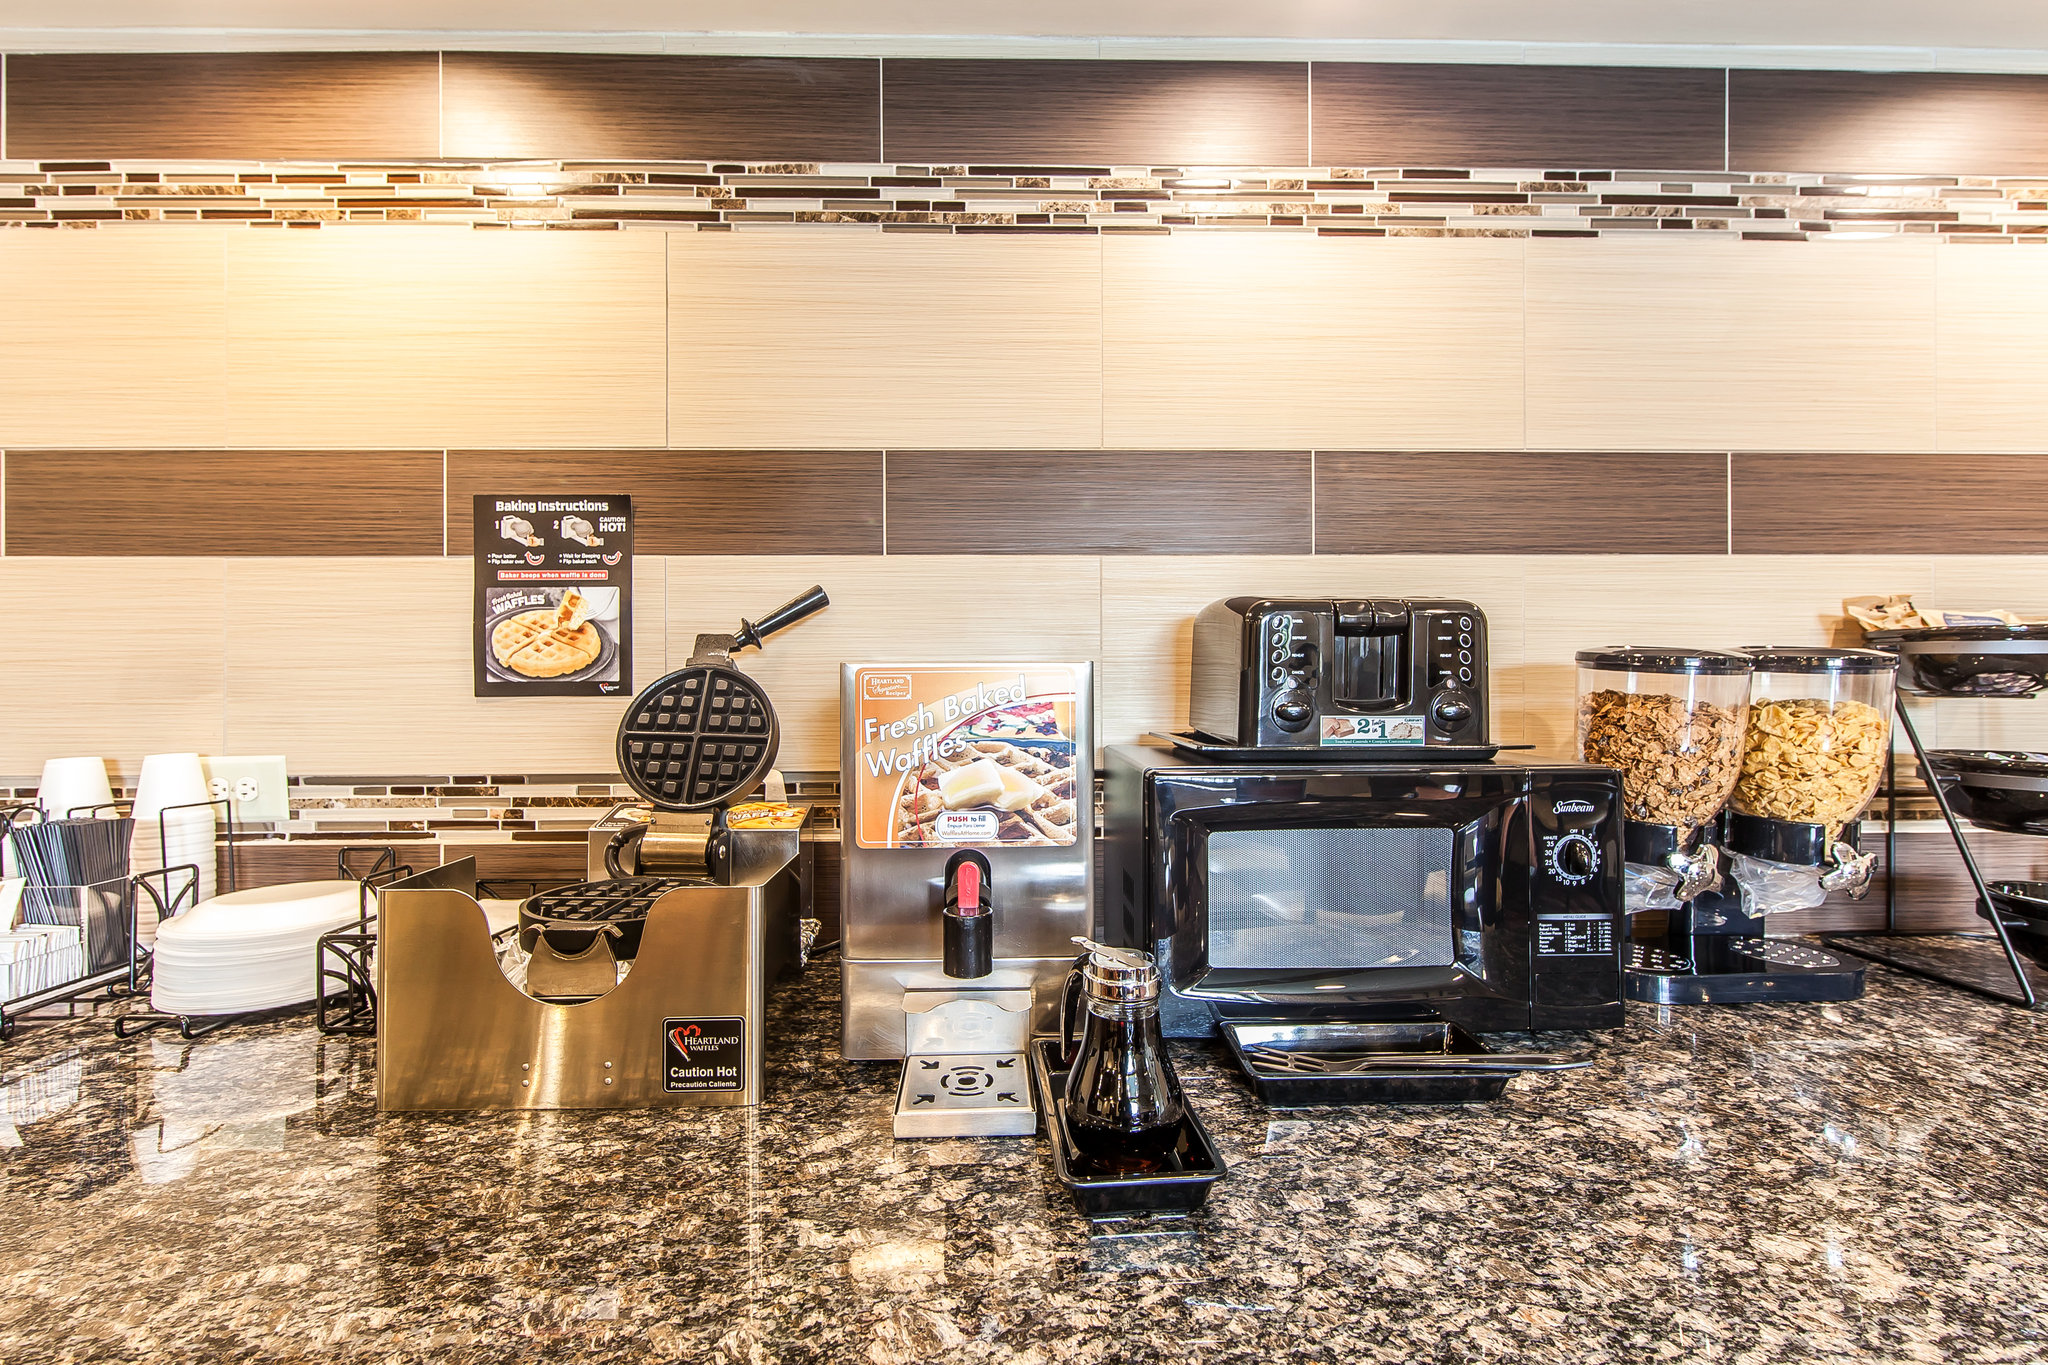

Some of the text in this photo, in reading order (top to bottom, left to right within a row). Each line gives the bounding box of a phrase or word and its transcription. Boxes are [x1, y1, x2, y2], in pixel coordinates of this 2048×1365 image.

[496, 499, 609, 513] Baking Instructions
[494, 520, 500, 530] 1
[553, 520, 559, 530] 2
[599, 523, 626, 532] HOT!
[492, 594, 545, 614] WAFFLES
[864, 673, 1027, 744] Fresh Baked
[1357, 718, 1370, 734] 2
[1378, 723, 1388, 738] 1
[864, 732, 968, 778] Waffles
[1552, 800, 1594, 814] Sunbeam
[684, 1036, 738, 1046] HEARTLAND
[670, 1066, 737, 1078] Caution Hot
